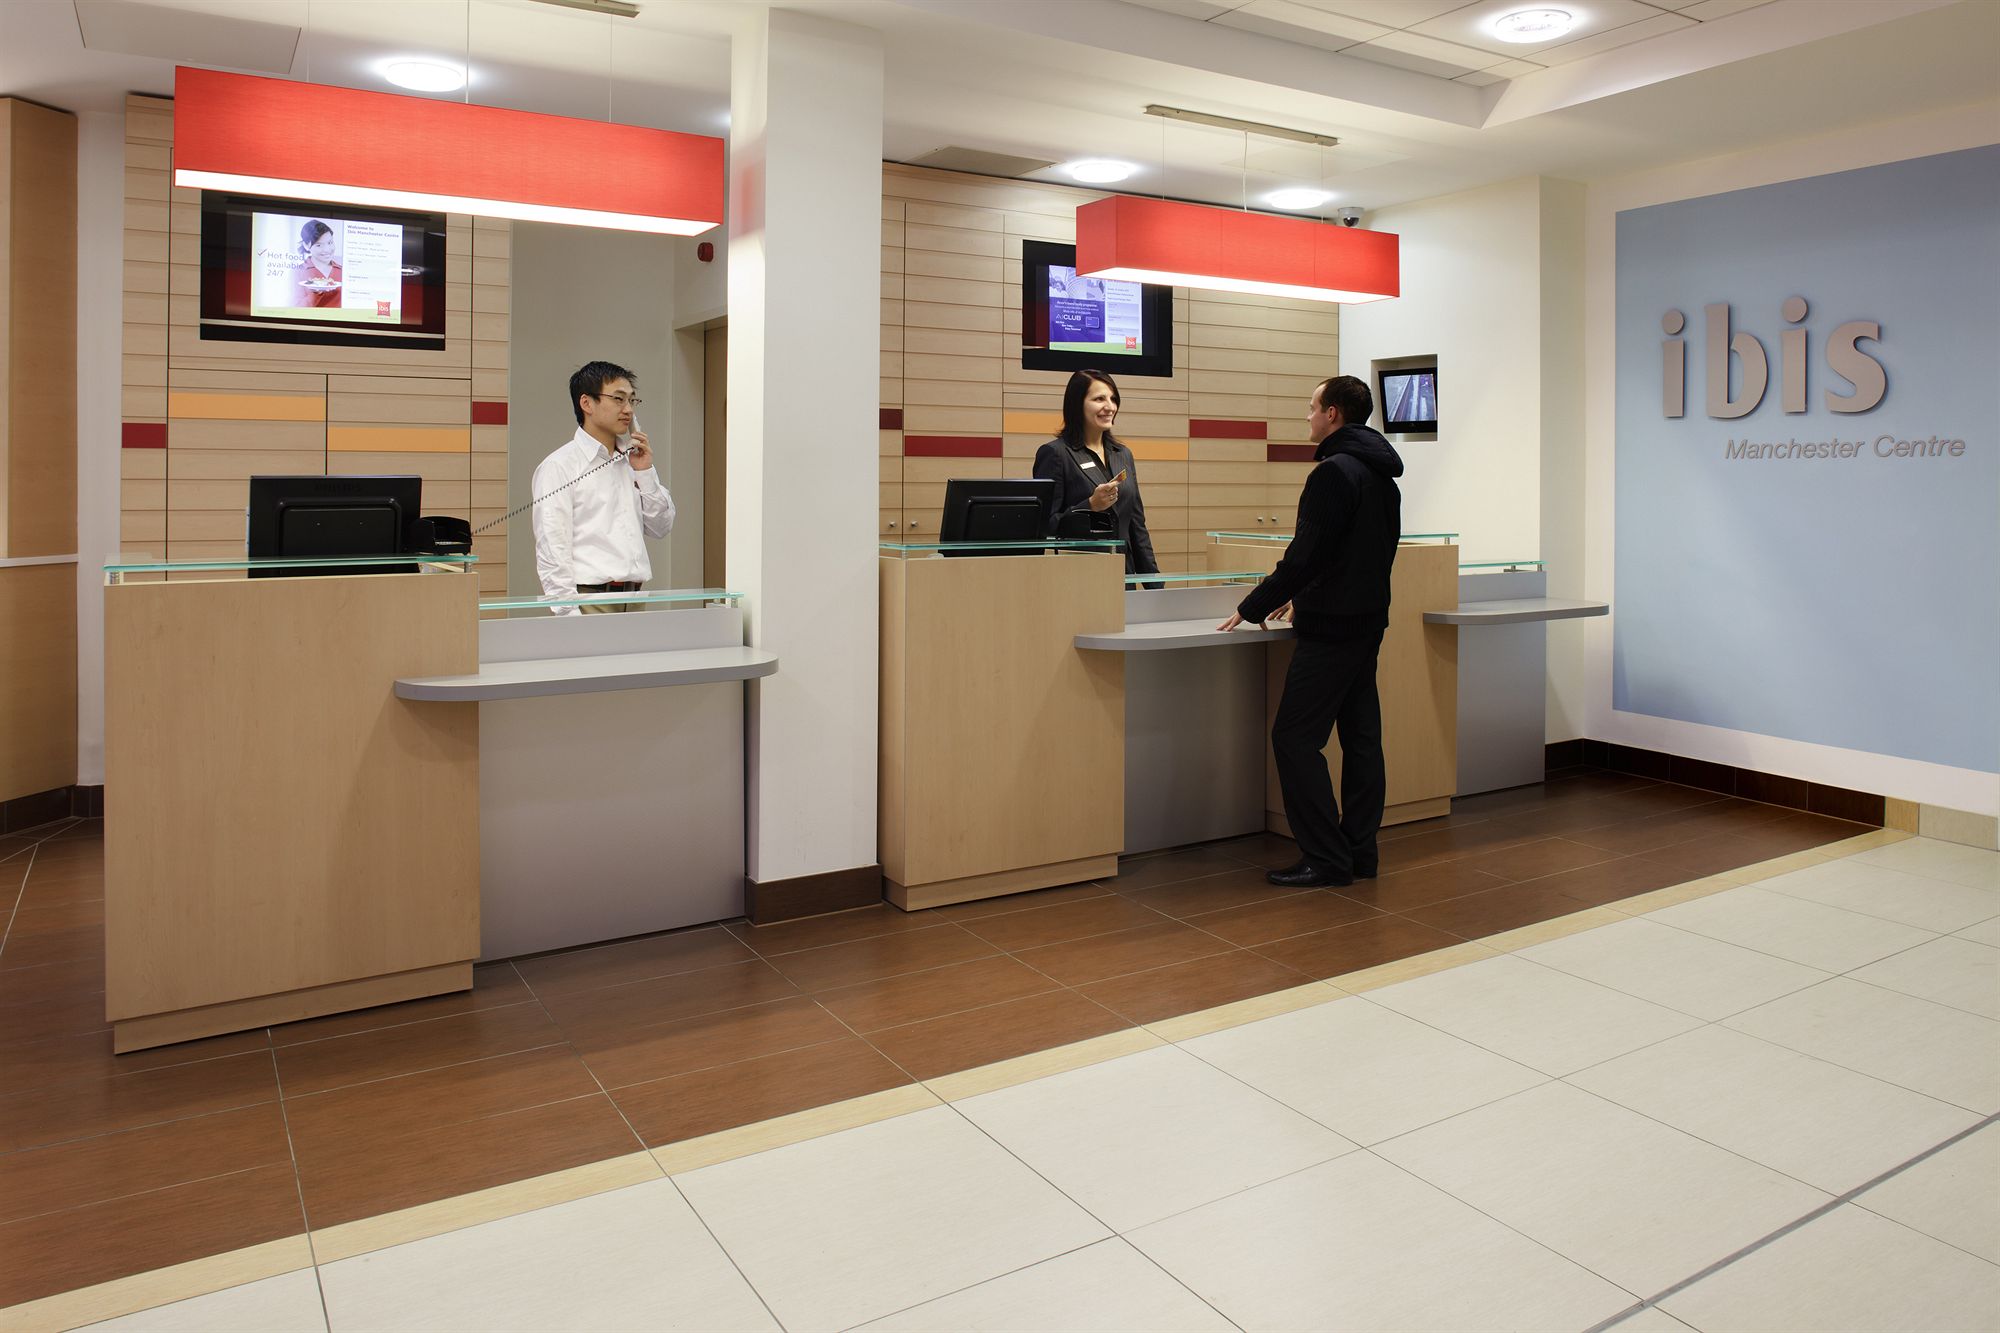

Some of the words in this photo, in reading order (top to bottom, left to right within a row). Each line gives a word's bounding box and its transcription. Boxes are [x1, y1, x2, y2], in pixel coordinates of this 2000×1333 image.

[267, 250, 282, 260] Hot
[285, 252, 305, 261] food
[266, 260, 304, 270] available
[266, 269, 285, 277] 24/7
[1662, 296, 1888, 419] ibis
[1725, 437, 1865, 460] Manchester
[1873, 434, 1966, 458] Centre
